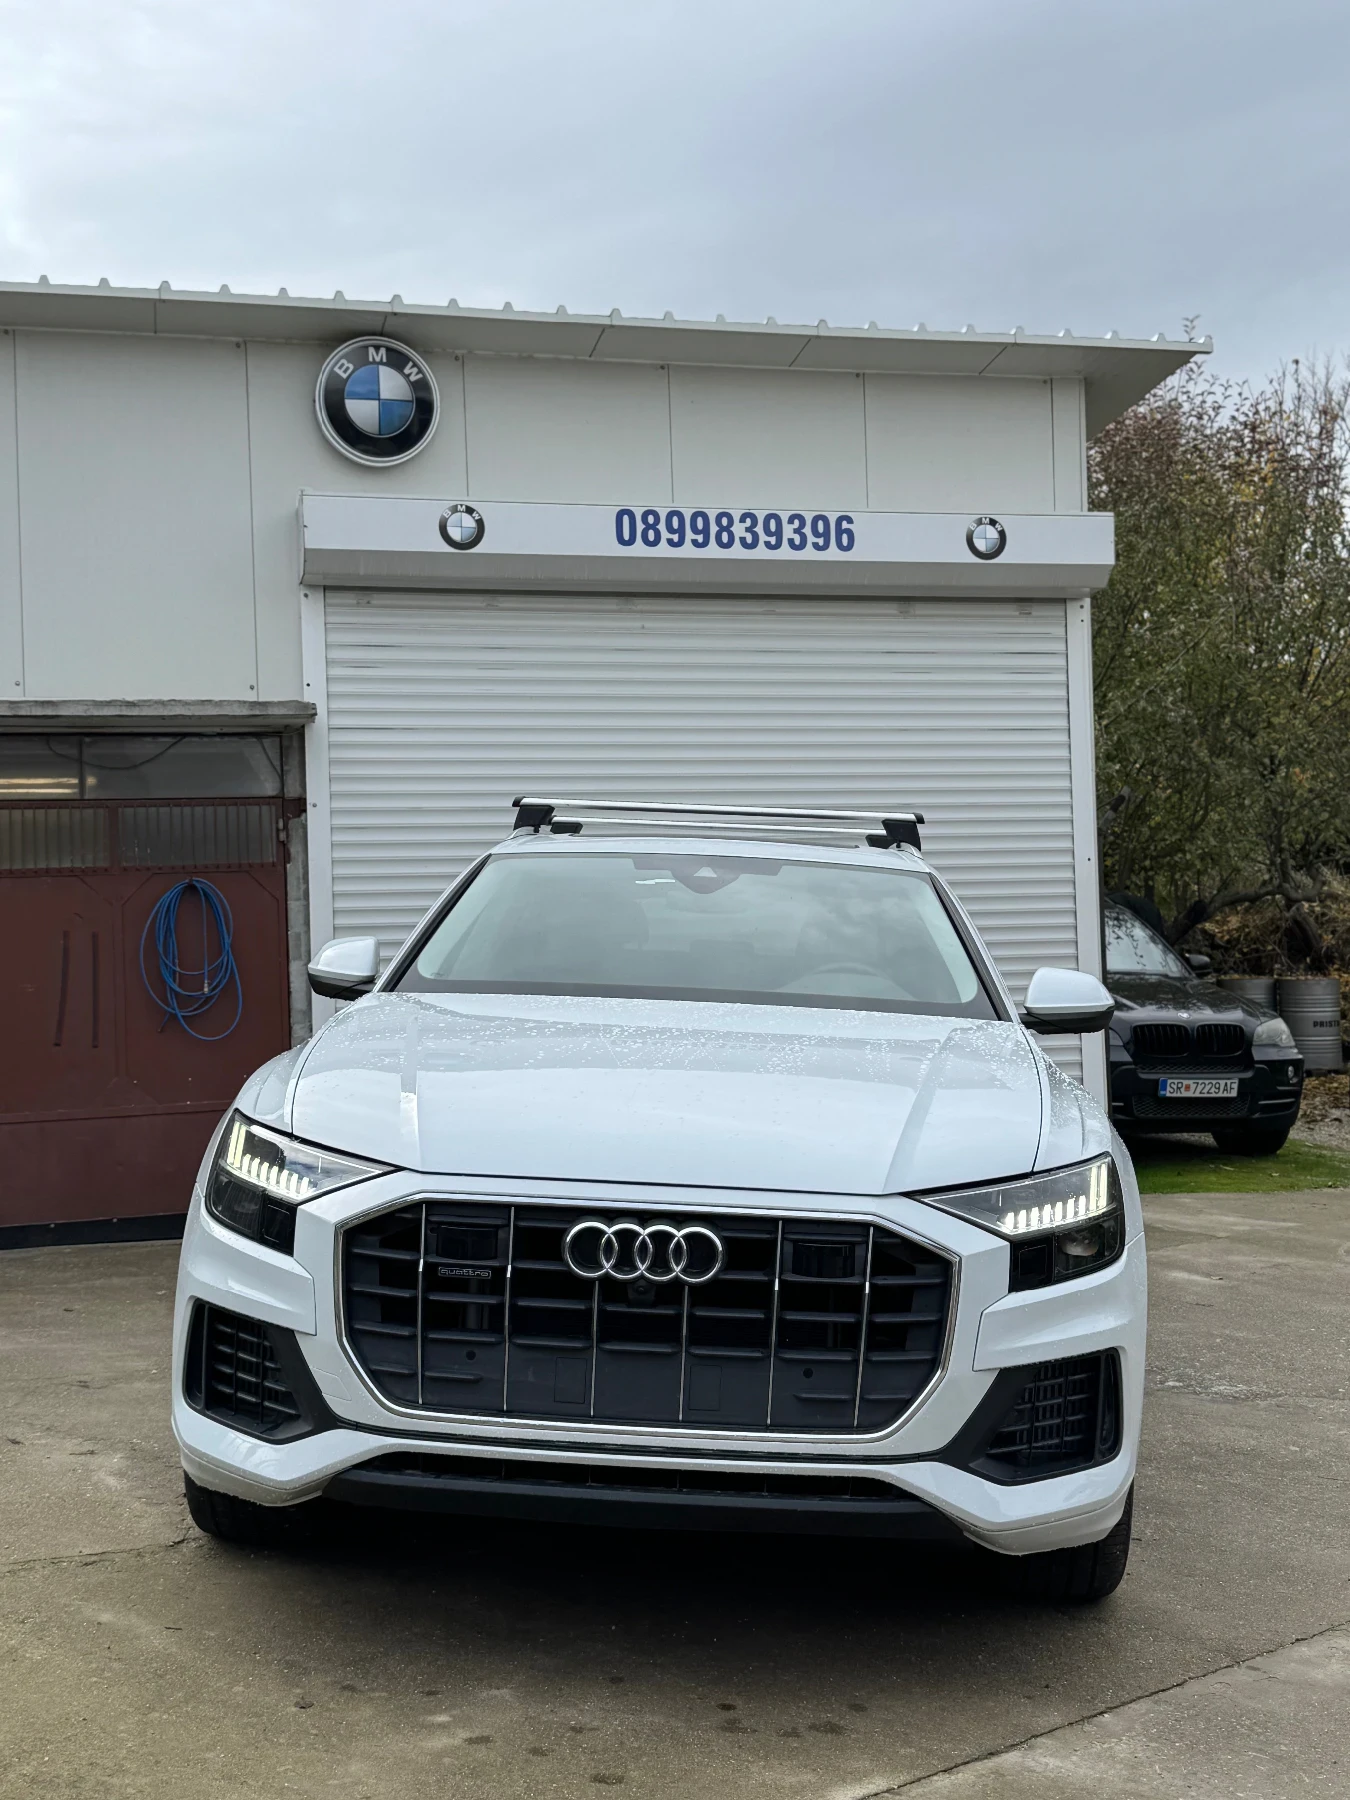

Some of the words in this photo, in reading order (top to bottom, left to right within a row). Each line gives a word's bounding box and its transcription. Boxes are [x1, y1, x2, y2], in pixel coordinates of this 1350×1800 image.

[334, 346, 423, 382] BMW
[443, 504, 481, 520] BMW
[615, 508, 856, 552] 0899839396
[969, 517, 1003, 531] BMW
[1168, 1081, 1183, 1095] SR
[1192, 1081, 1221, 1095] 7229
[1222, 1081, 1237, 1095] AF
[440, 1269, 489, 1277] quattro
